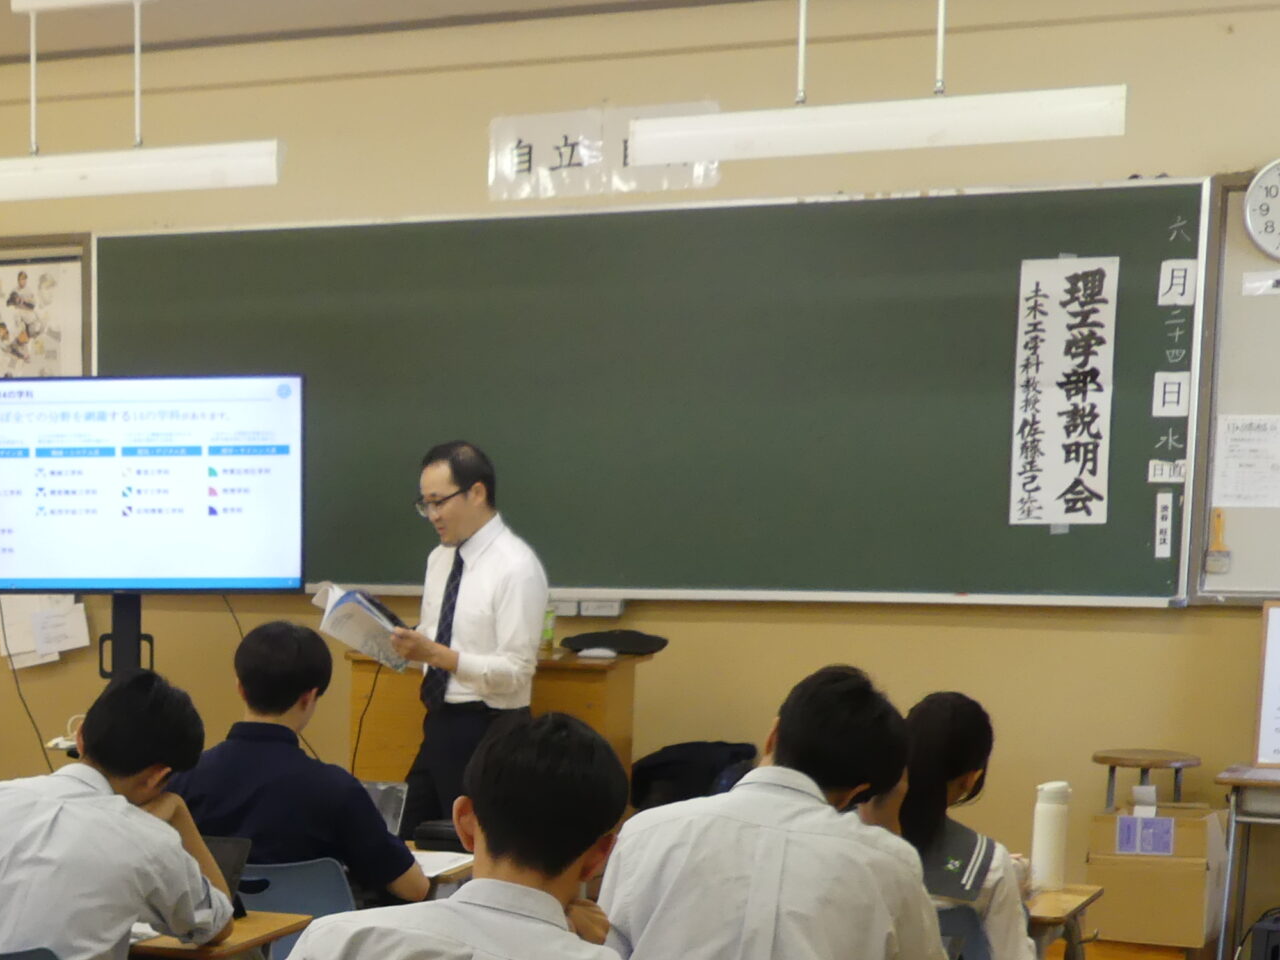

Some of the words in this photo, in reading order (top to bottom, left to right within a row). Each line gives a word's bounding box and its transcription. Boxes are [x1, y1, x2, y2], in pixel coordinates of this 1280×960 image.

[1264, 185, 1280, 199] 10
[1258, 202, 1270, 217] 9
[1264, 220, 1276, 234] 8
[1055, 267, 1109, 516] 理工学部説明会
